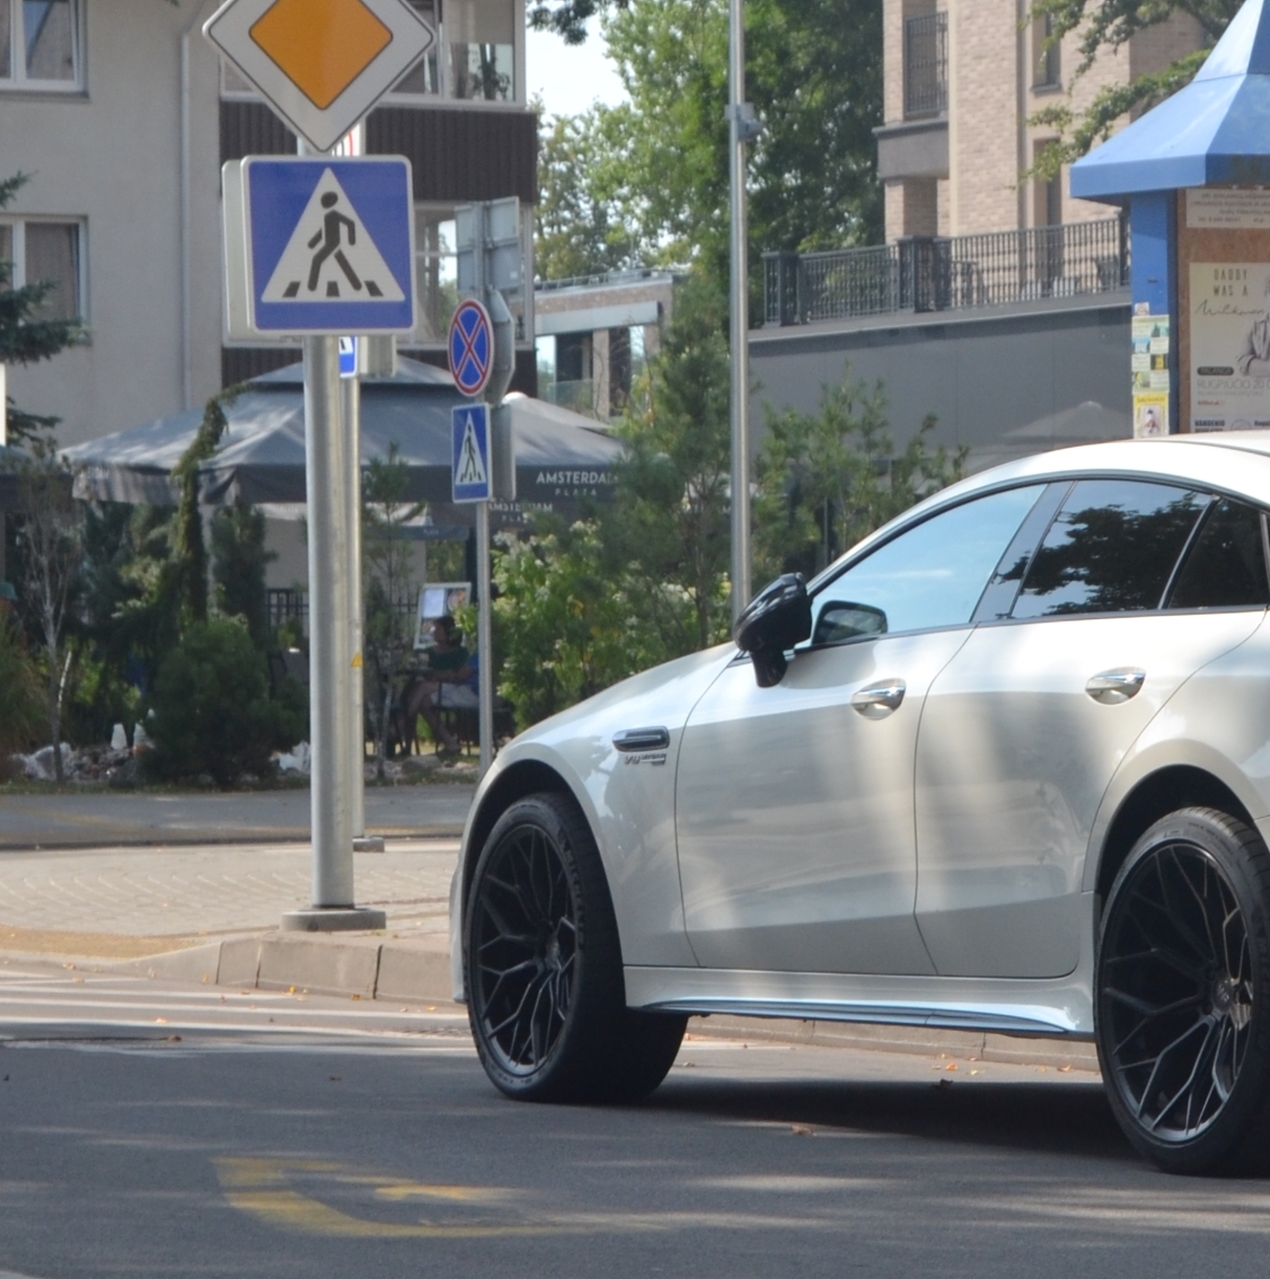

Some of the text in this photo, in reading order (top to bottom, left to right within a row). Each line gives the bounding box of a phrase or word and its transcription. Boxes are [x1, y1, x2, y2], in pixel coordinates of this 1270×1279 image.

[1213, 268, 1247, 280] DADDY
[1213, 285, 1248, 296] WAS A
[488, 503, 553, 512] AMSTEDAM
